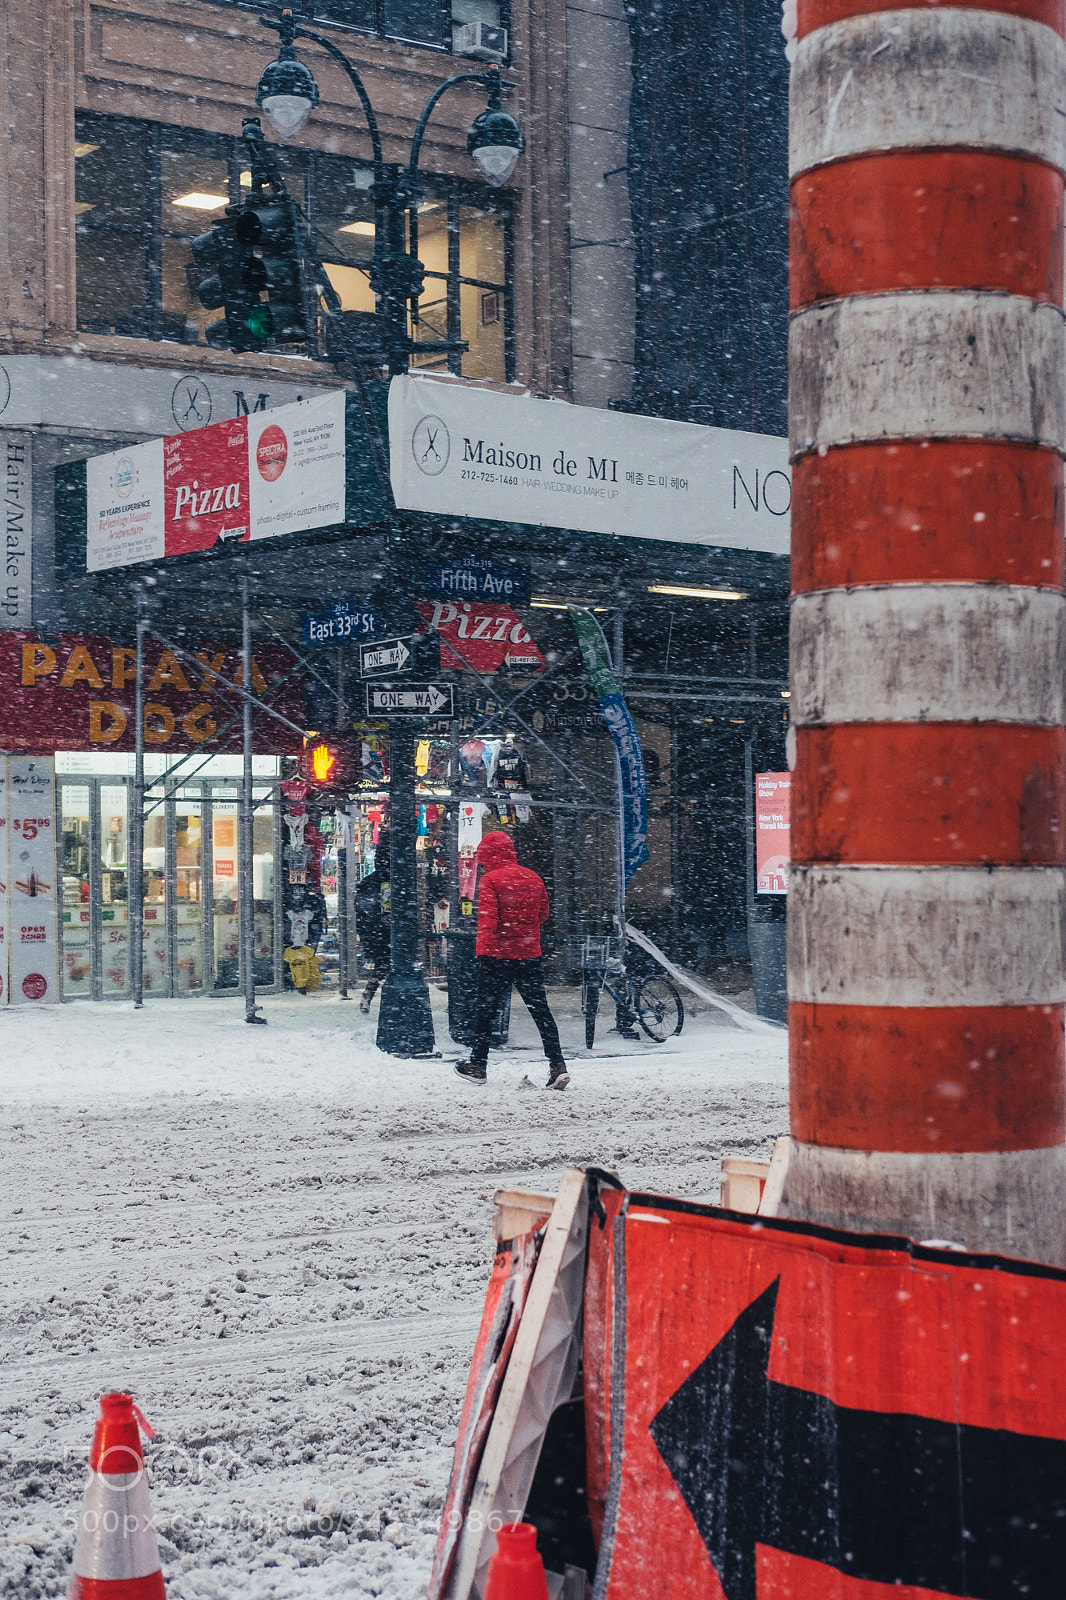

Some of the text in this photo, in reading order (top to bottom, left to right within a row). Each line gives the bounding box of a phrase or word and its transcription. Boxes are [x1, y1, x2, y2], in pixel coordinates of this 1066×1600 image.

[258, 443, 286, 458] SPECTRA
[461, 437, 619, 483] Maison de MI
[461, 469, 518, 486] 212-725-1460
[583, 486, 606, 499] MAKE
[607, 489, 619, 499] UP
[106, 505, 122, 517] YEARS
[121, 499, 151, 514] EXPERIENCE
[172, 480, 241, 521] Pizza
[256, 501, 340, 526] photo digital custom framing
[440, 569, 514, 595] Fifth Ave
[1, 585, 19, 617] up
[310, 612, 375, 640] East 33rd St
[431, 603, 531, 645] Pizza
[368, 647, 405, 667] ONE WAY
[21, 643, 269, 695] PAPAYA
[380, 692, 440, 706] ONE WAY
[88, 700, 218, 745] DOG
[28, 763, 36, 772] 2
[758, 781, 778, 790] Holiday
[758, 789, 774, 797] Show
[758, 814, 784, 822] New York
[758, 822, 777, 830] Transit
[21, 925, 46, 933] OPEN
